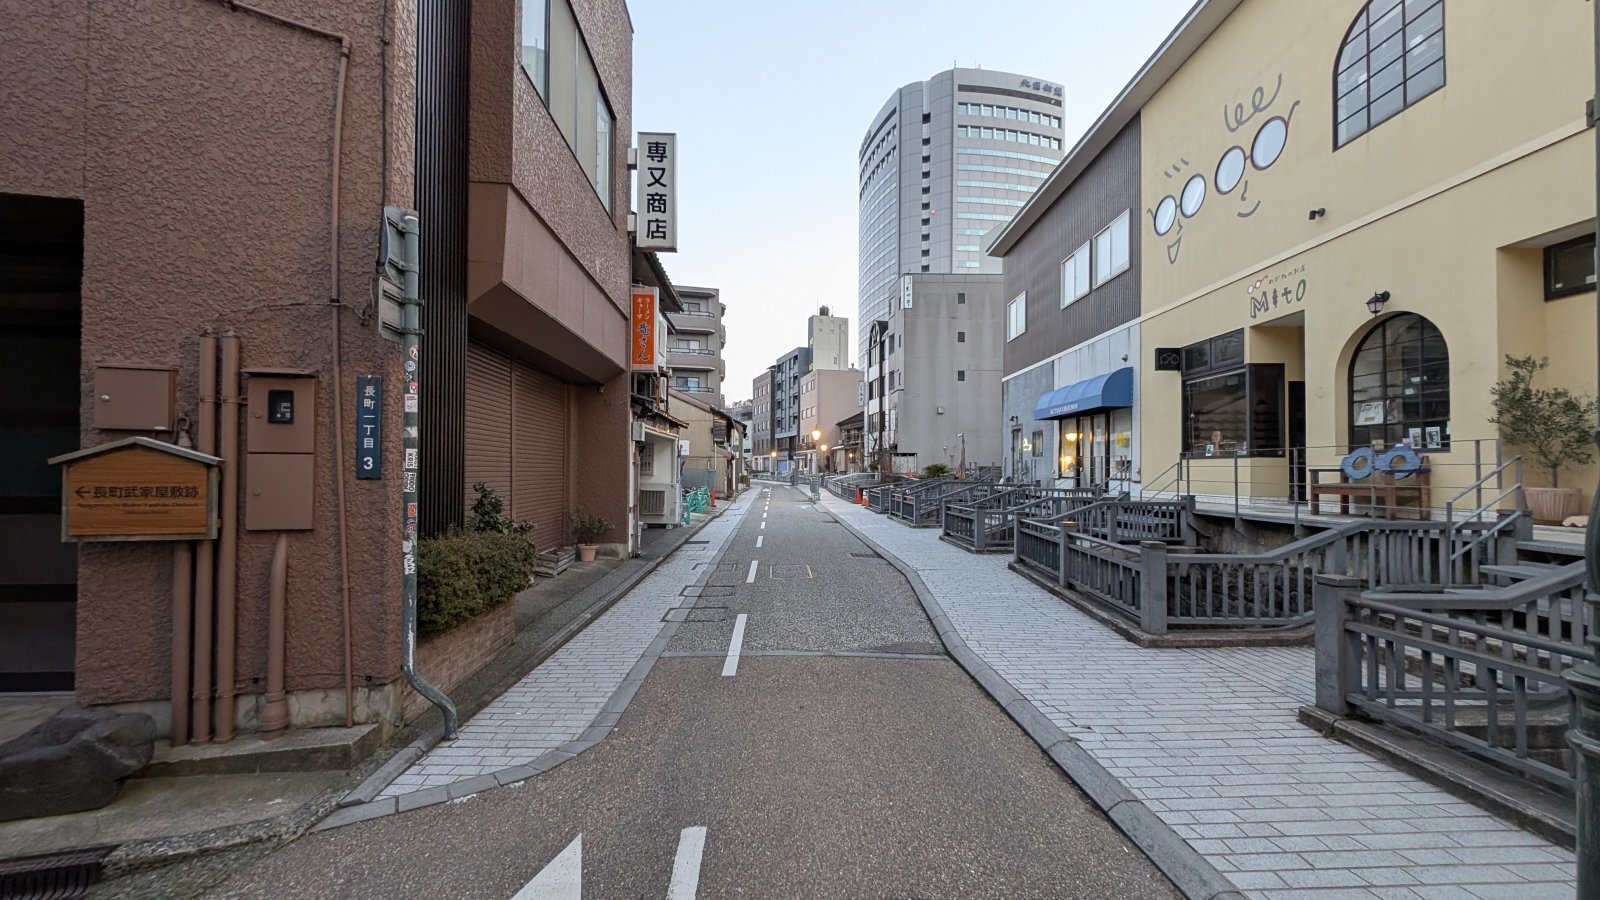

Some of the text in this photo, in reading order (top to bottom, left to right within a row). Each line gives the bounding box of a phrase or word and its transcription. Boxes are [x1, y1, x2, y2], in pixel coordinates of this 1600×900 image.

[646, 140, 668, 240] 専又商店
[363, 385, 375, 470] 長町一丁目 3
[93, 485, 199, 499] 長町武家屋敷跡
